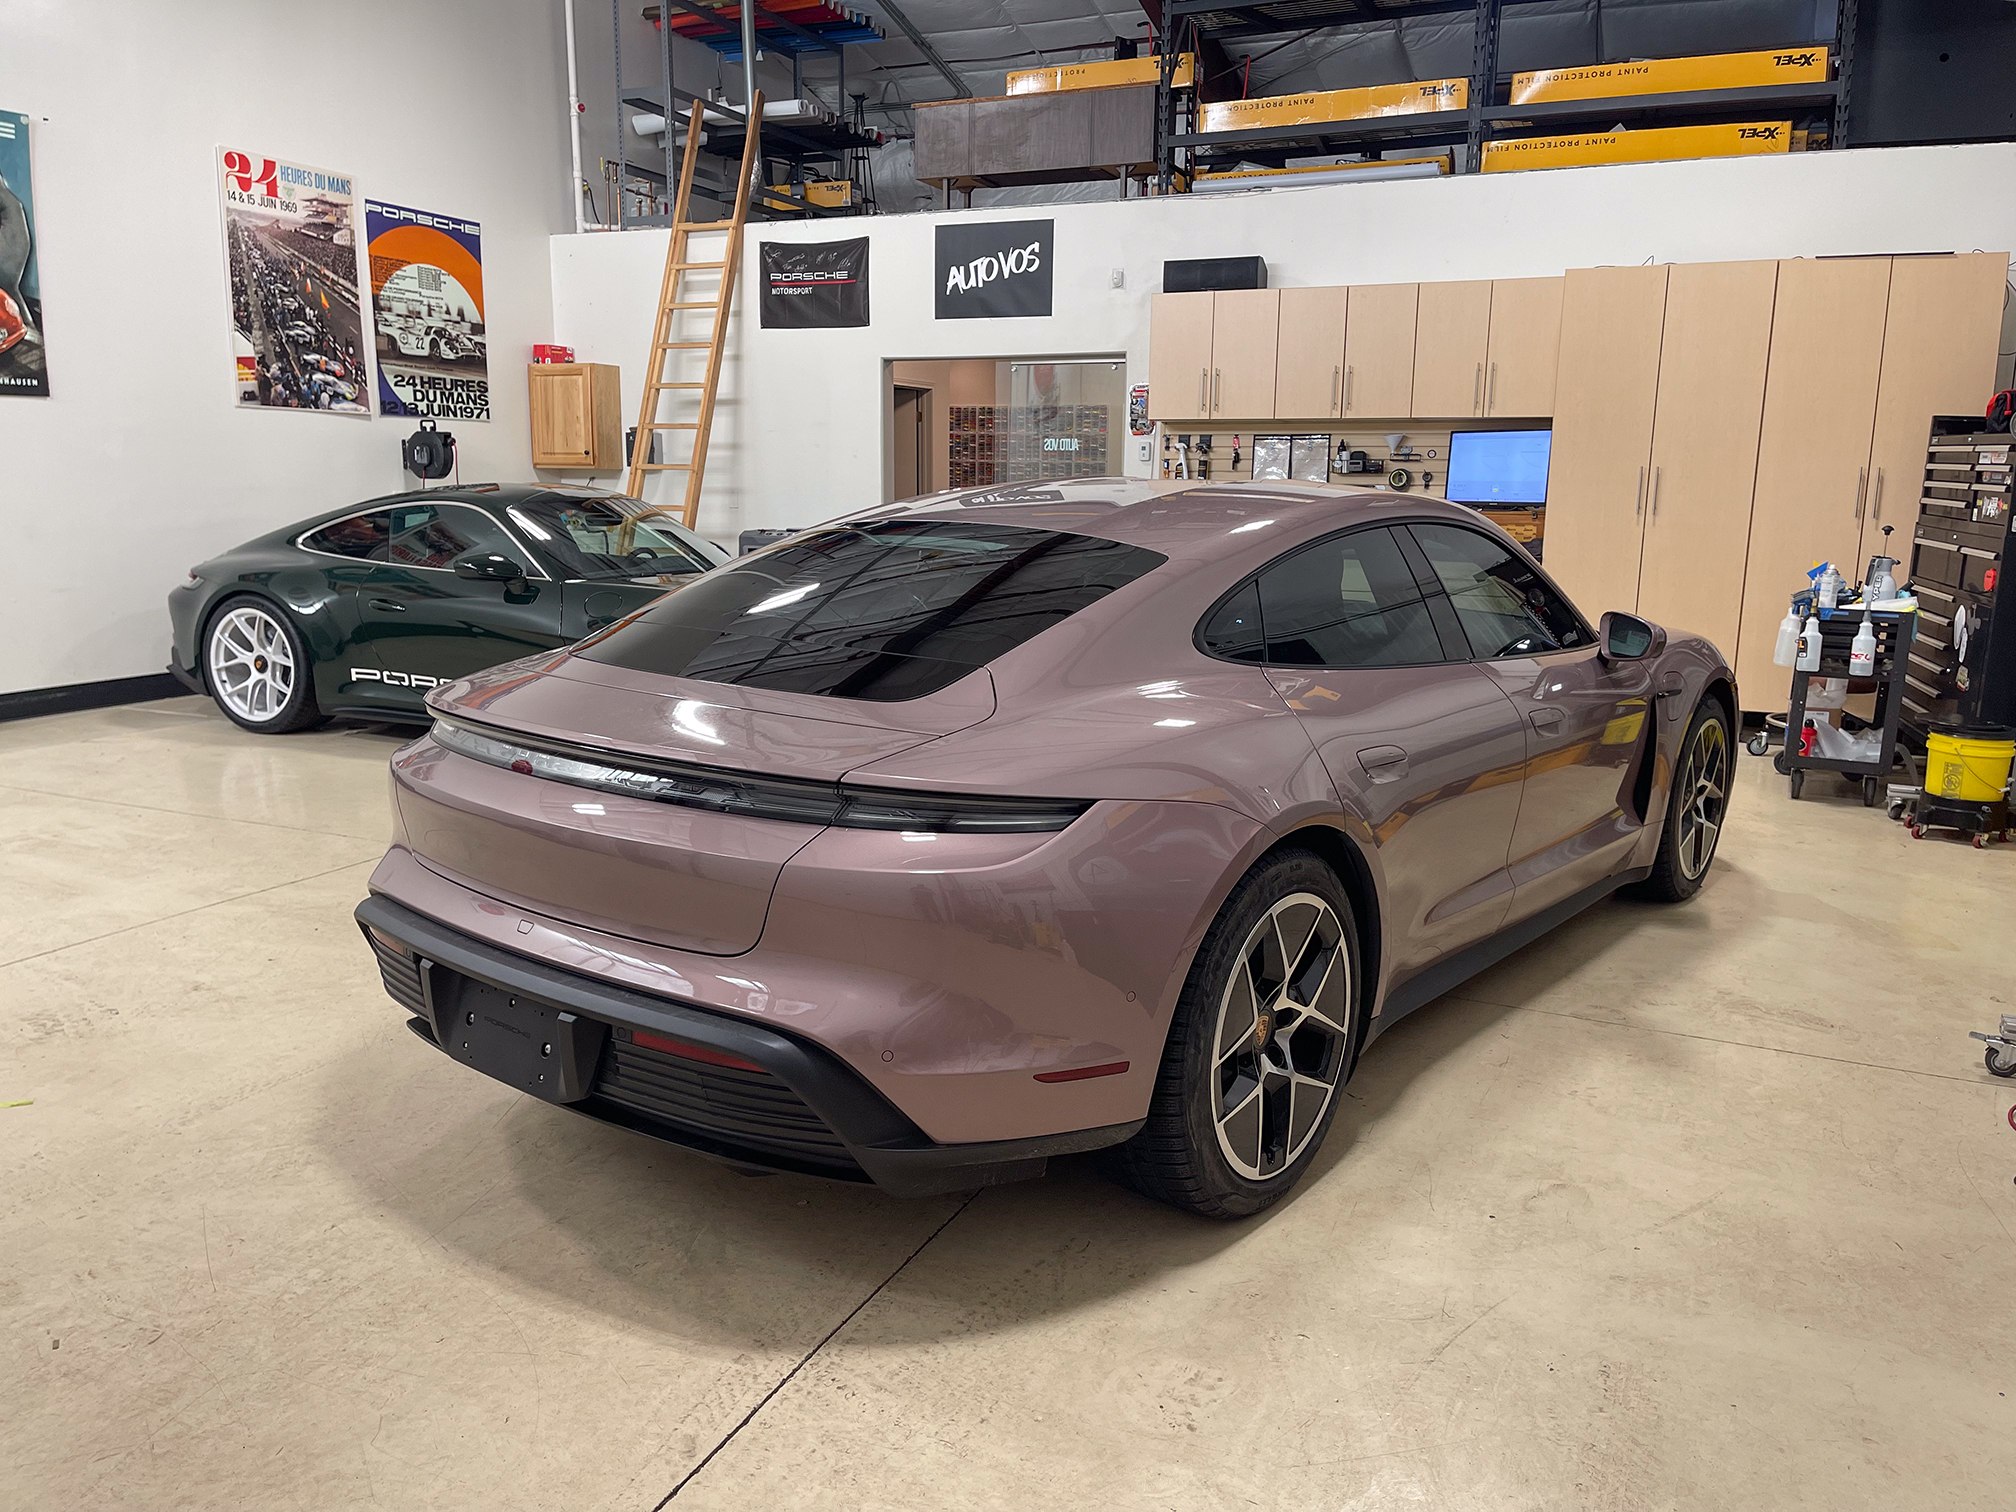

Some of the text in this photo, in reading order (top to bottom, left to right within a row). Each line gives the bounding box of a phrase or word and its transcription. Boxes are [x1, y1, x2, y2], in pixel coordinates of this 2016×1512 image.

[1773, 52, 1816, 67] XPEL
[1545, 69, 1612, 82] PROTECTION
[1617, 66, 1649, 76] PAINT
[1227, 100, 1284, 112] PROTECTION
[1287, 97, 1315, 107] PAINT
[1738, 126, 1780, 140] XPEL
[1514, 139, 1580, 151] PROTECTION
[1585, 137, 1616, 146] PAINT
[224, 151, 282, 199] 24
[279, 164, 313, 189] HEURES
[314, 172, 326, 191] DU
[327, 175, 352, 196] MANS
[227, 189, 237, 202] 14
[246, 193, 256, 206] 15
[258, 196, 277, 210] JUIN
[279, 199, 298, 214] 1969
[365, 203, 481, 236] PORSCHE
[946, 241, 1040, 296] AUTO VOS
[770, 270, 849, 282] PORSCHE
[771, 286, 813, 295] MOTORSPORT
[415, 336, 426, 351] 22
[393, 374, 489, 394] 24 HEURES
[413, 389, 490, 407] DU MANS
[420, 403, 458, 418] JUIN
[458, 405, 491, 420] 1971
